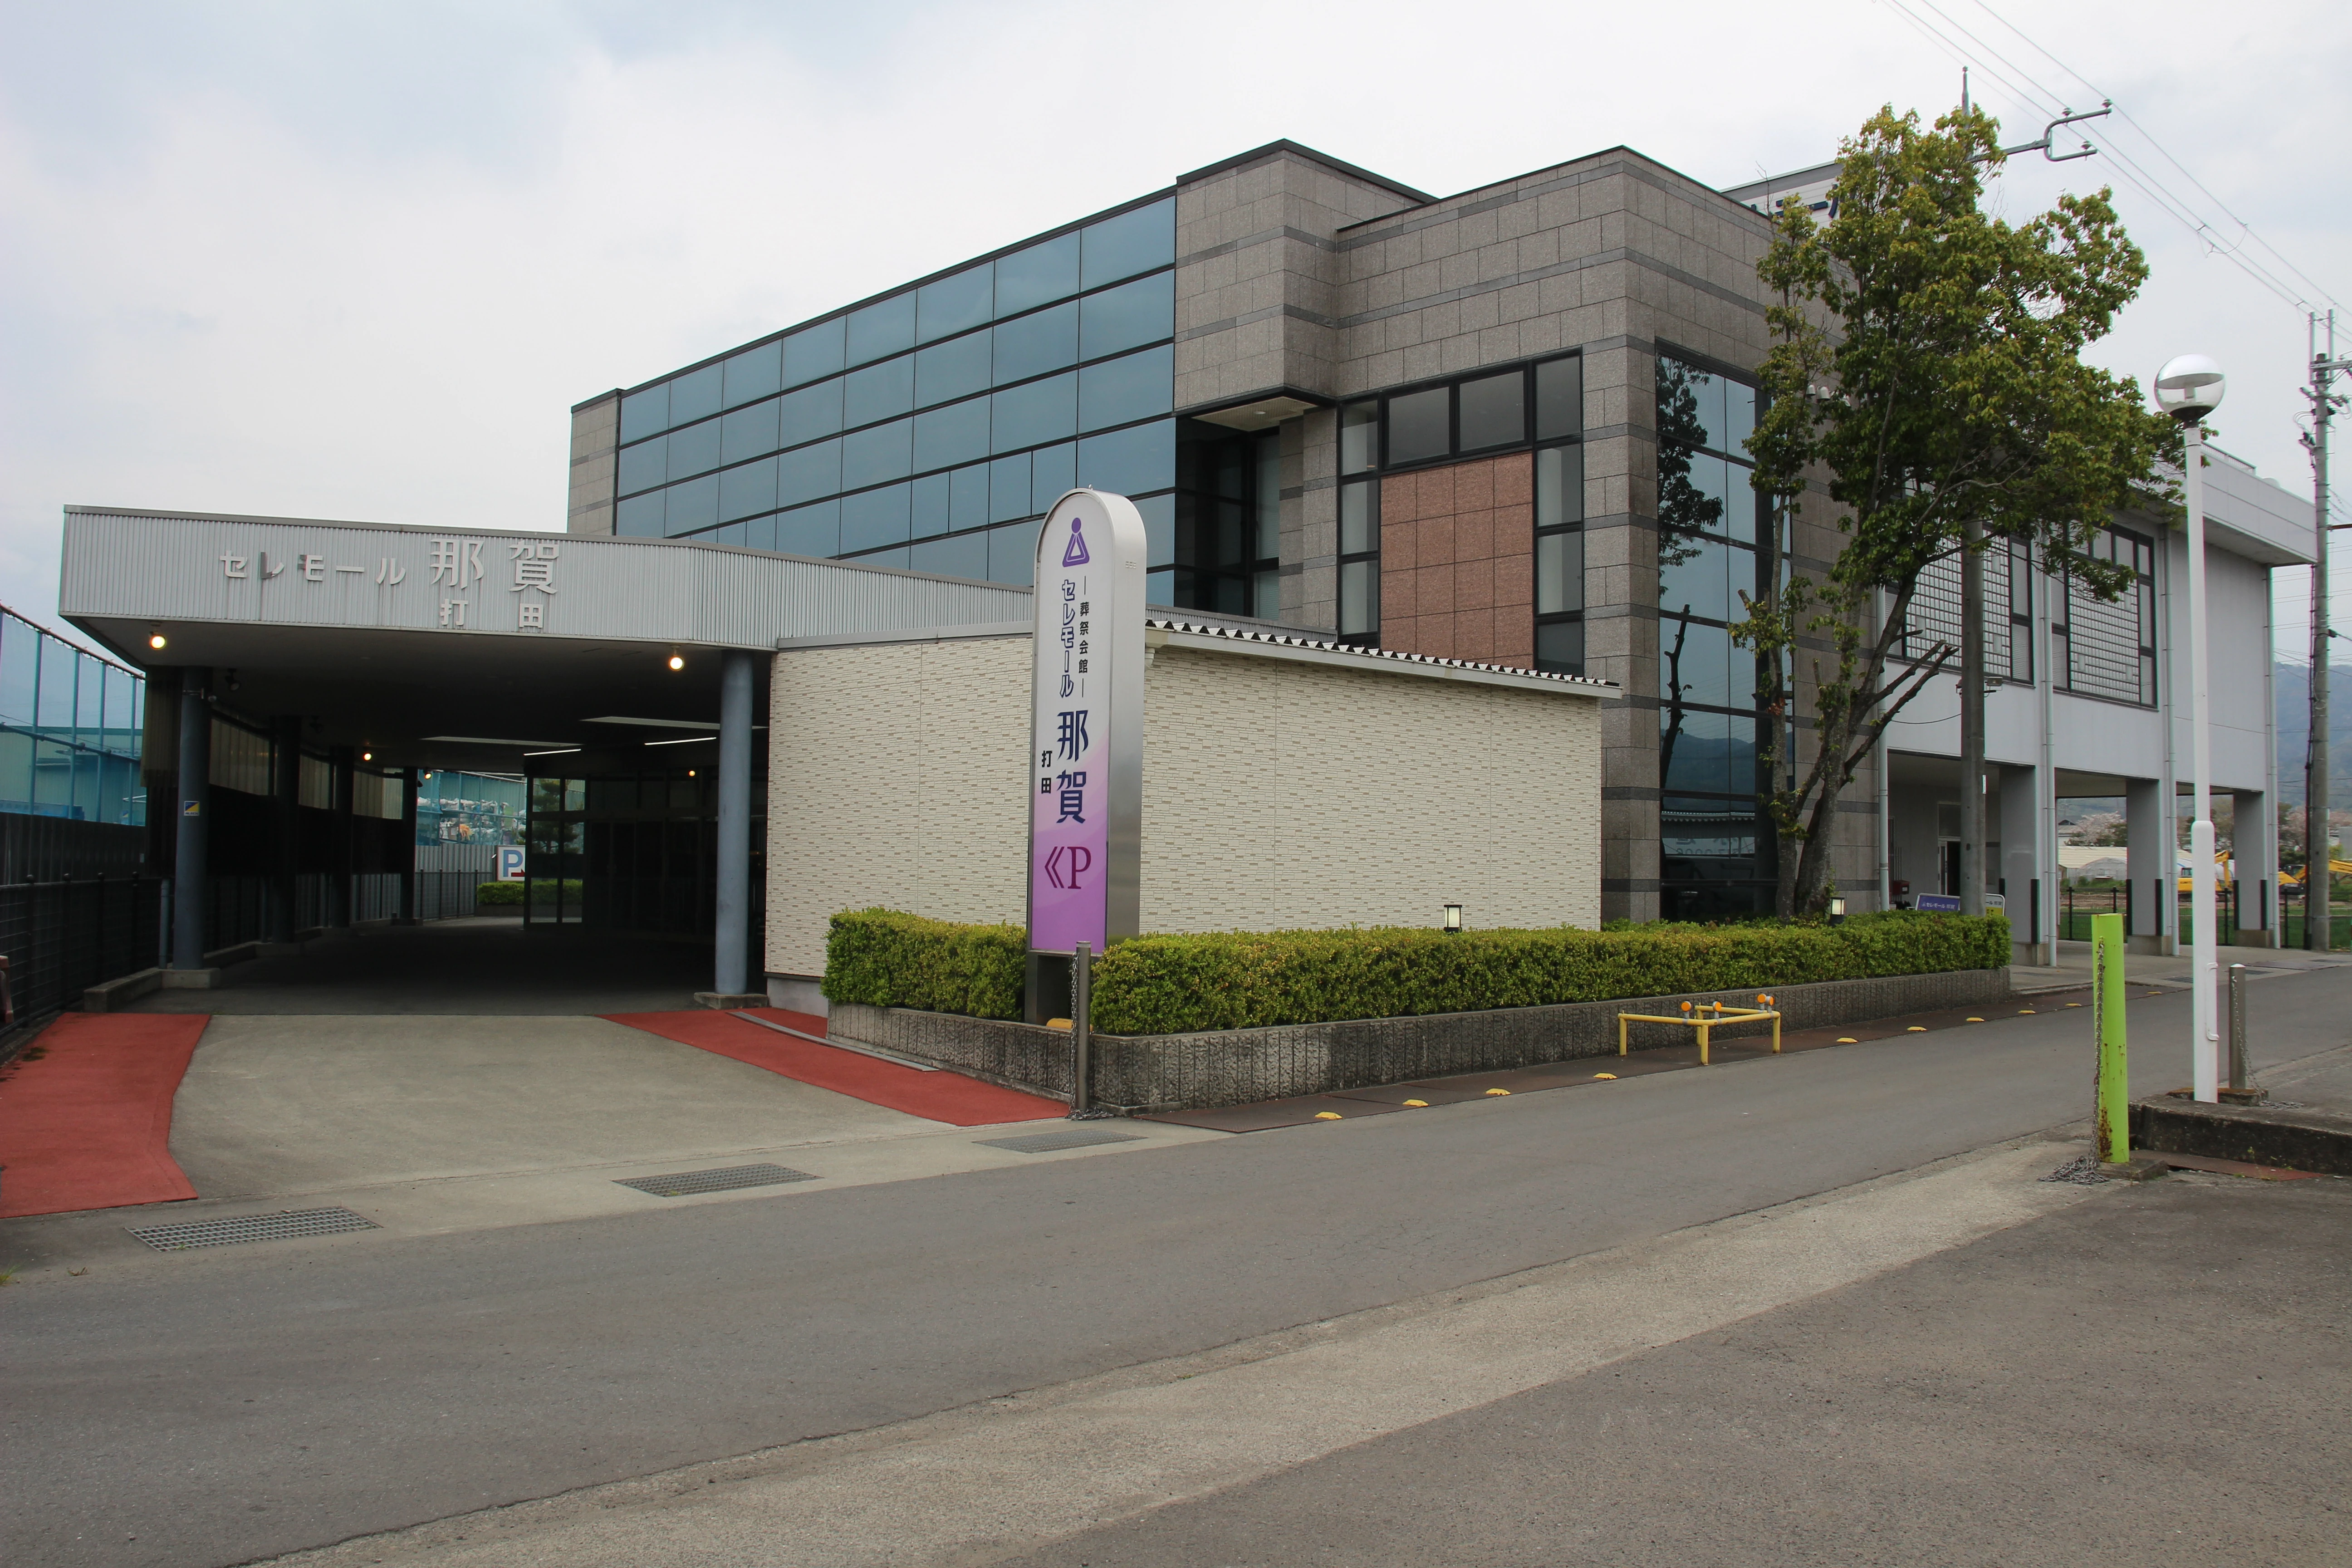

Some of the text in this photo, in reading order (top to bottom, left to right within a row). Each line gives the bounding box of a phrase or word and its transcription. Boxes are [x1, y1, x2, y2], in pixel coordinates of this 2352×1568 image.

[219, 538, 560, 595] セレモール 那賀
[440, 598, 544, 628] 打田
[1078, 602, 1089, 674] 葬祭会館
[1056, 579, 1088, 823] セレモール 那賀
[1041, 750, 1053, 794] 打田
[503, 849, 524, 877] P
